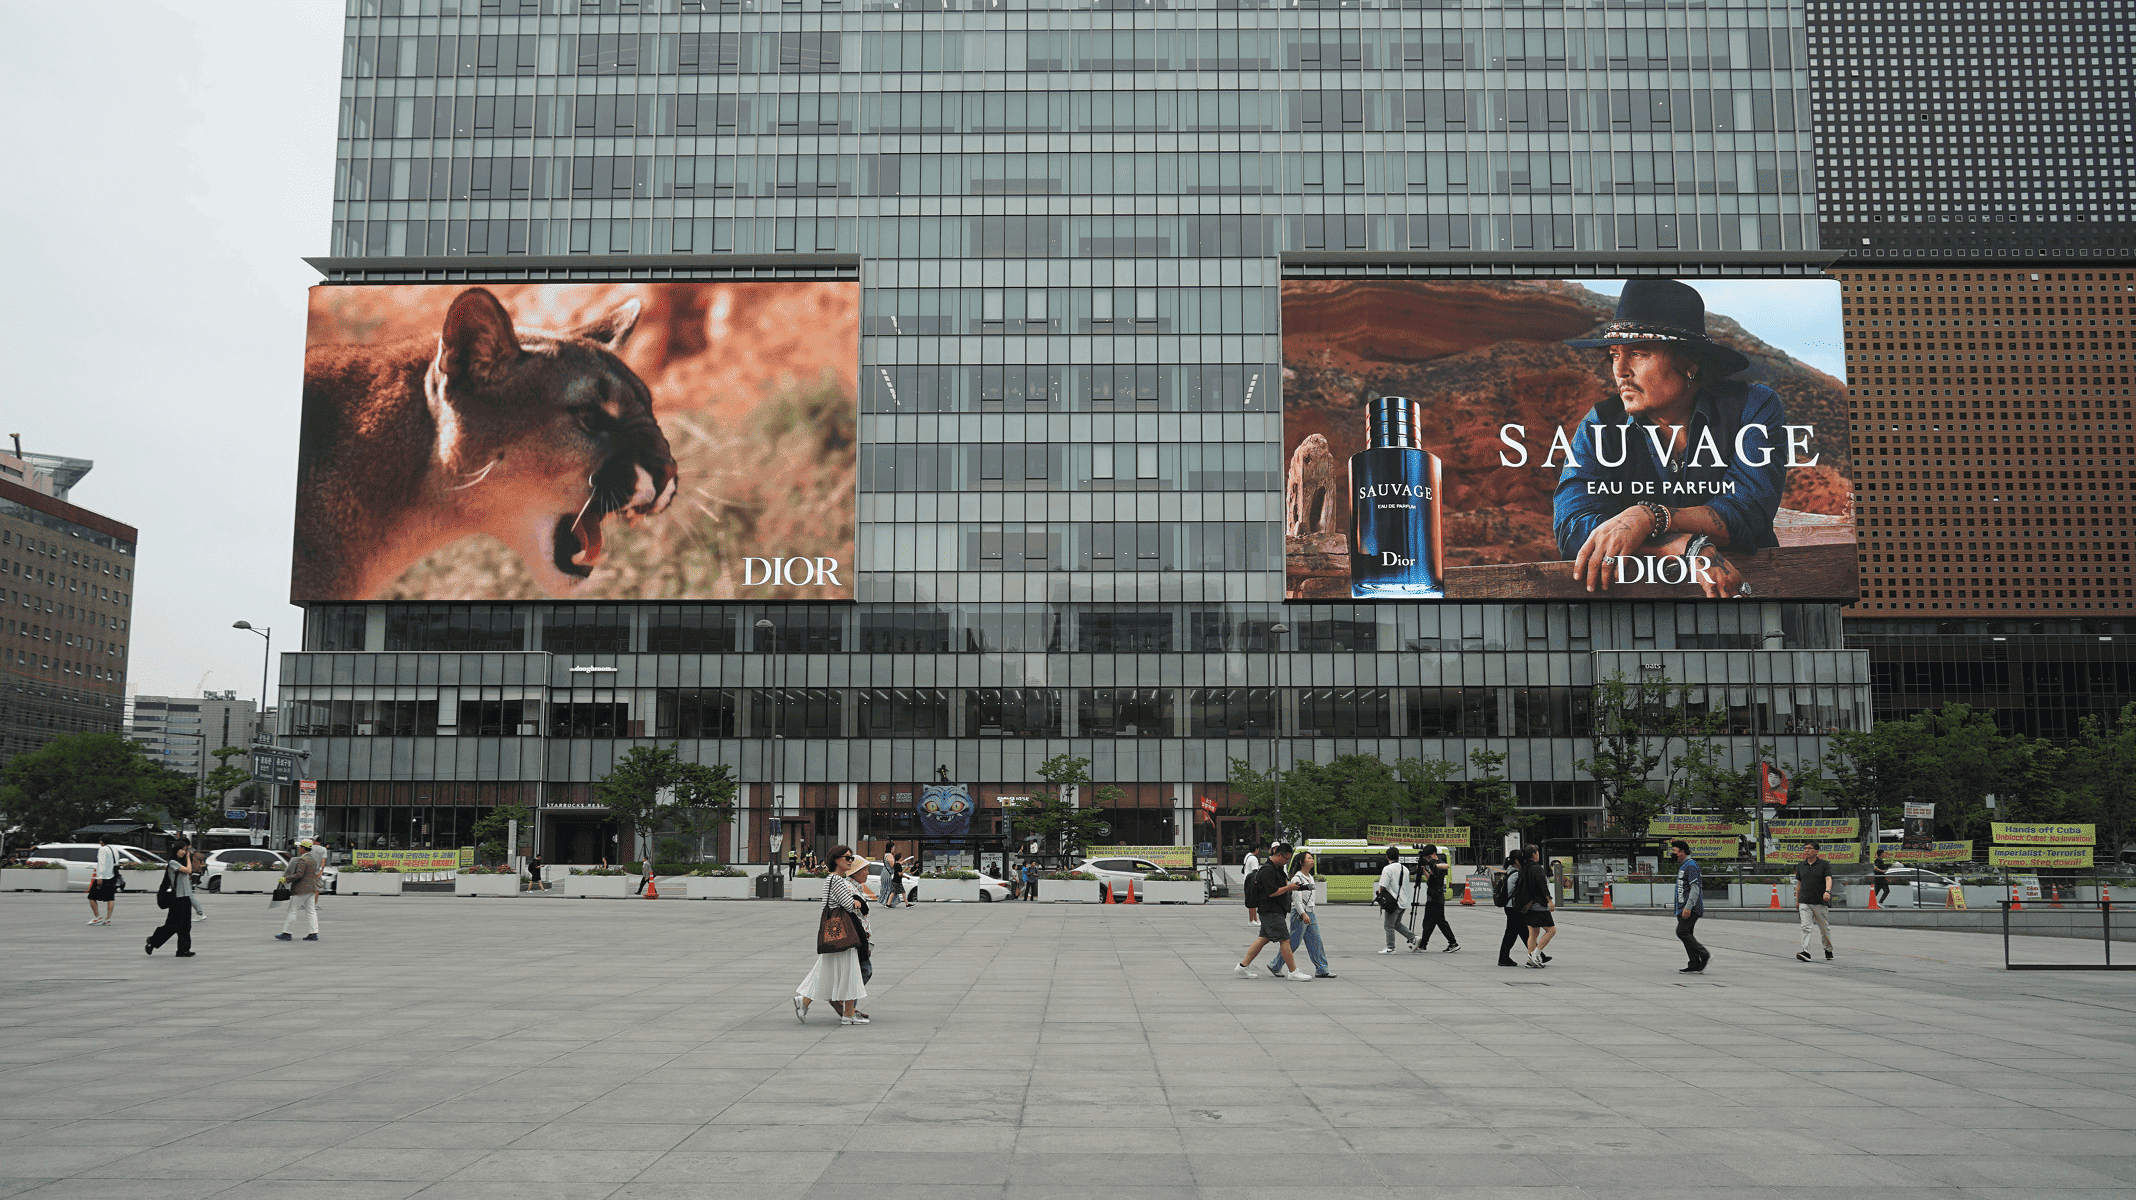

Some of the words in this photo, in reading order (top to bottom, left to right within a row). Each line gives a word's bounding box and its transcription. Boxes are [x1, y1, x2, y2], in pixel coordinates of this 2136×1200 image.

[1500, 423, 1820, 468] SAUVAGE
[1359, 483, 1433, 500] SAUVAGE
[1588, 481, 1624, 495] EAU
[1632, 481, 1655, 494] DE
[1663, 481, 1736, 495] PARFUM
[1382, 551, 1416, 566] Dior
[1614, 555, 1716, 585] DIOR
[741, 556, 842, 585] DIOR
